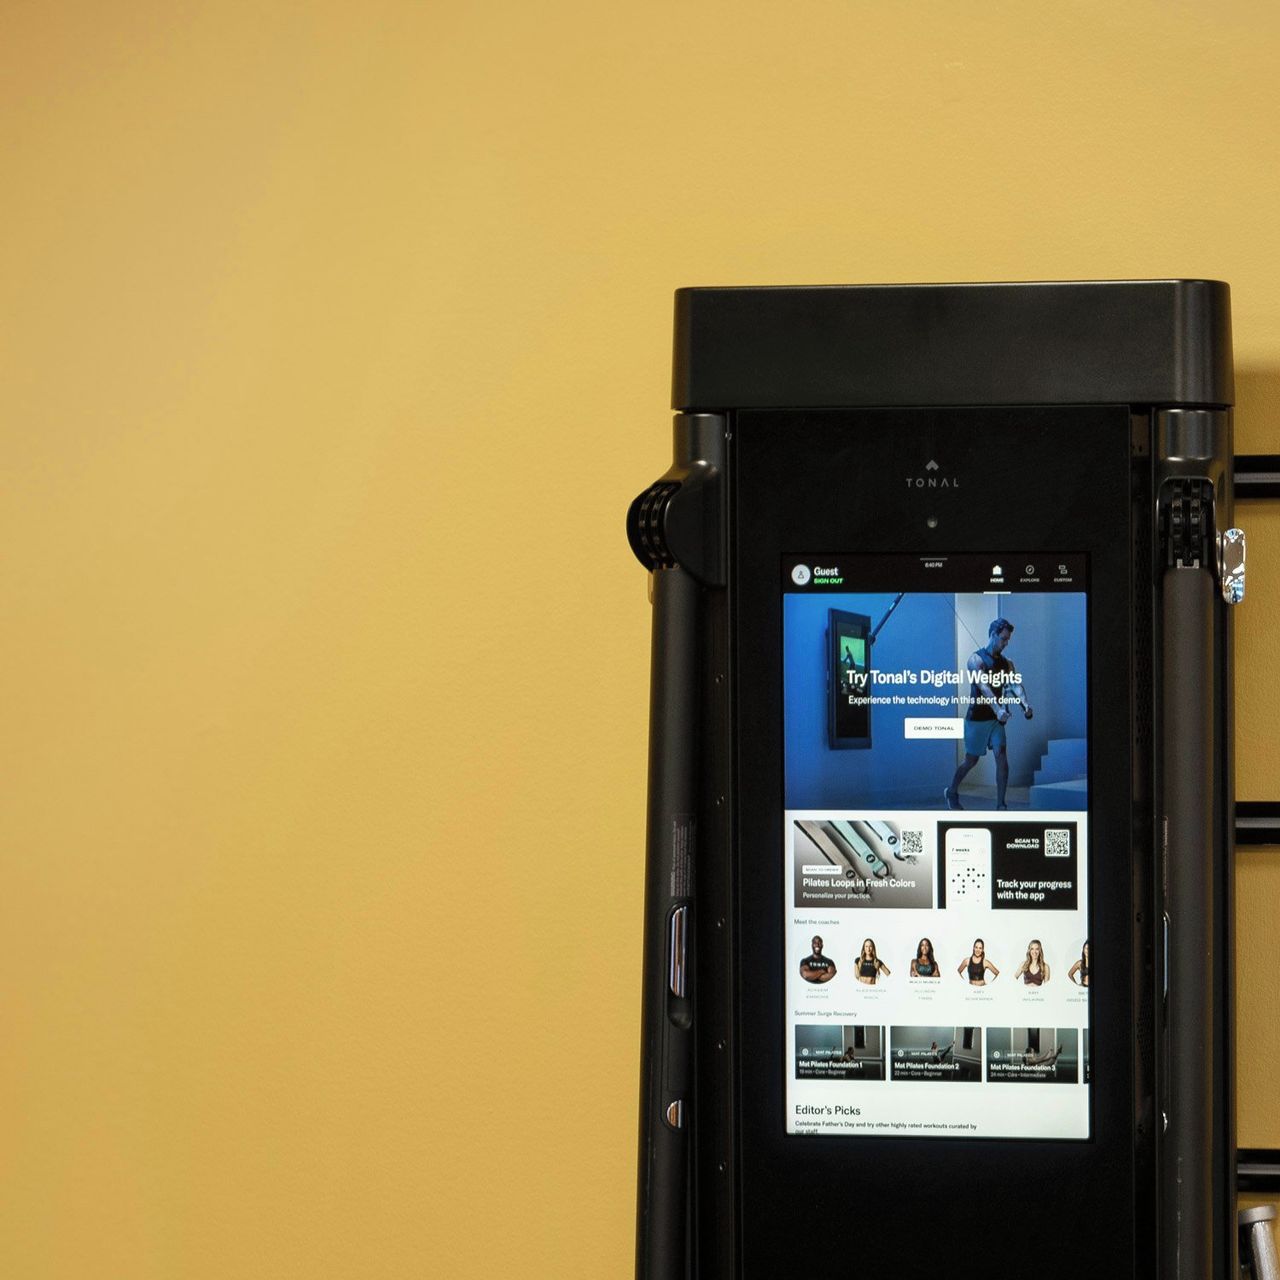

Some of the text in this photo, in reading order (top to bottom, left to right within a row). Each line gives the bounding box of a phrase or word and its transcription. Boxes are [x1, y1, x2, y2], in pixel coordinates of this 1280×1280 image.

[905, 477, 959, 488] TONAL
[813, 566, 839, 576] Guest
[846, 669, 1022, 688] Try Tonal's Digital Weights
[848, 695, 1021, 706] Experience the technology in this short demo
[802, 877, 916, 889] Pilates Loops in Fresh Colors
[996, 879, 1073, 890] Track your progress
[996, 890, 1046, 901] with the app
[799, 1060, 810, 1068] Mat
[811, 1060, 829, 1068] Pilates
[829, 1060, 859, 1068] Foundation
[894, 1061, 906, 1069] Mat
[906, 1061, 924, 1069] Pilates
[924, 1062, 955, 1070] Foundation
[1002, 1063, 1020, 1071] Pilates
[1020, 1063, 1051, 1071] Foundation
[795, 1104, 861, 1115] Editor's Picks
